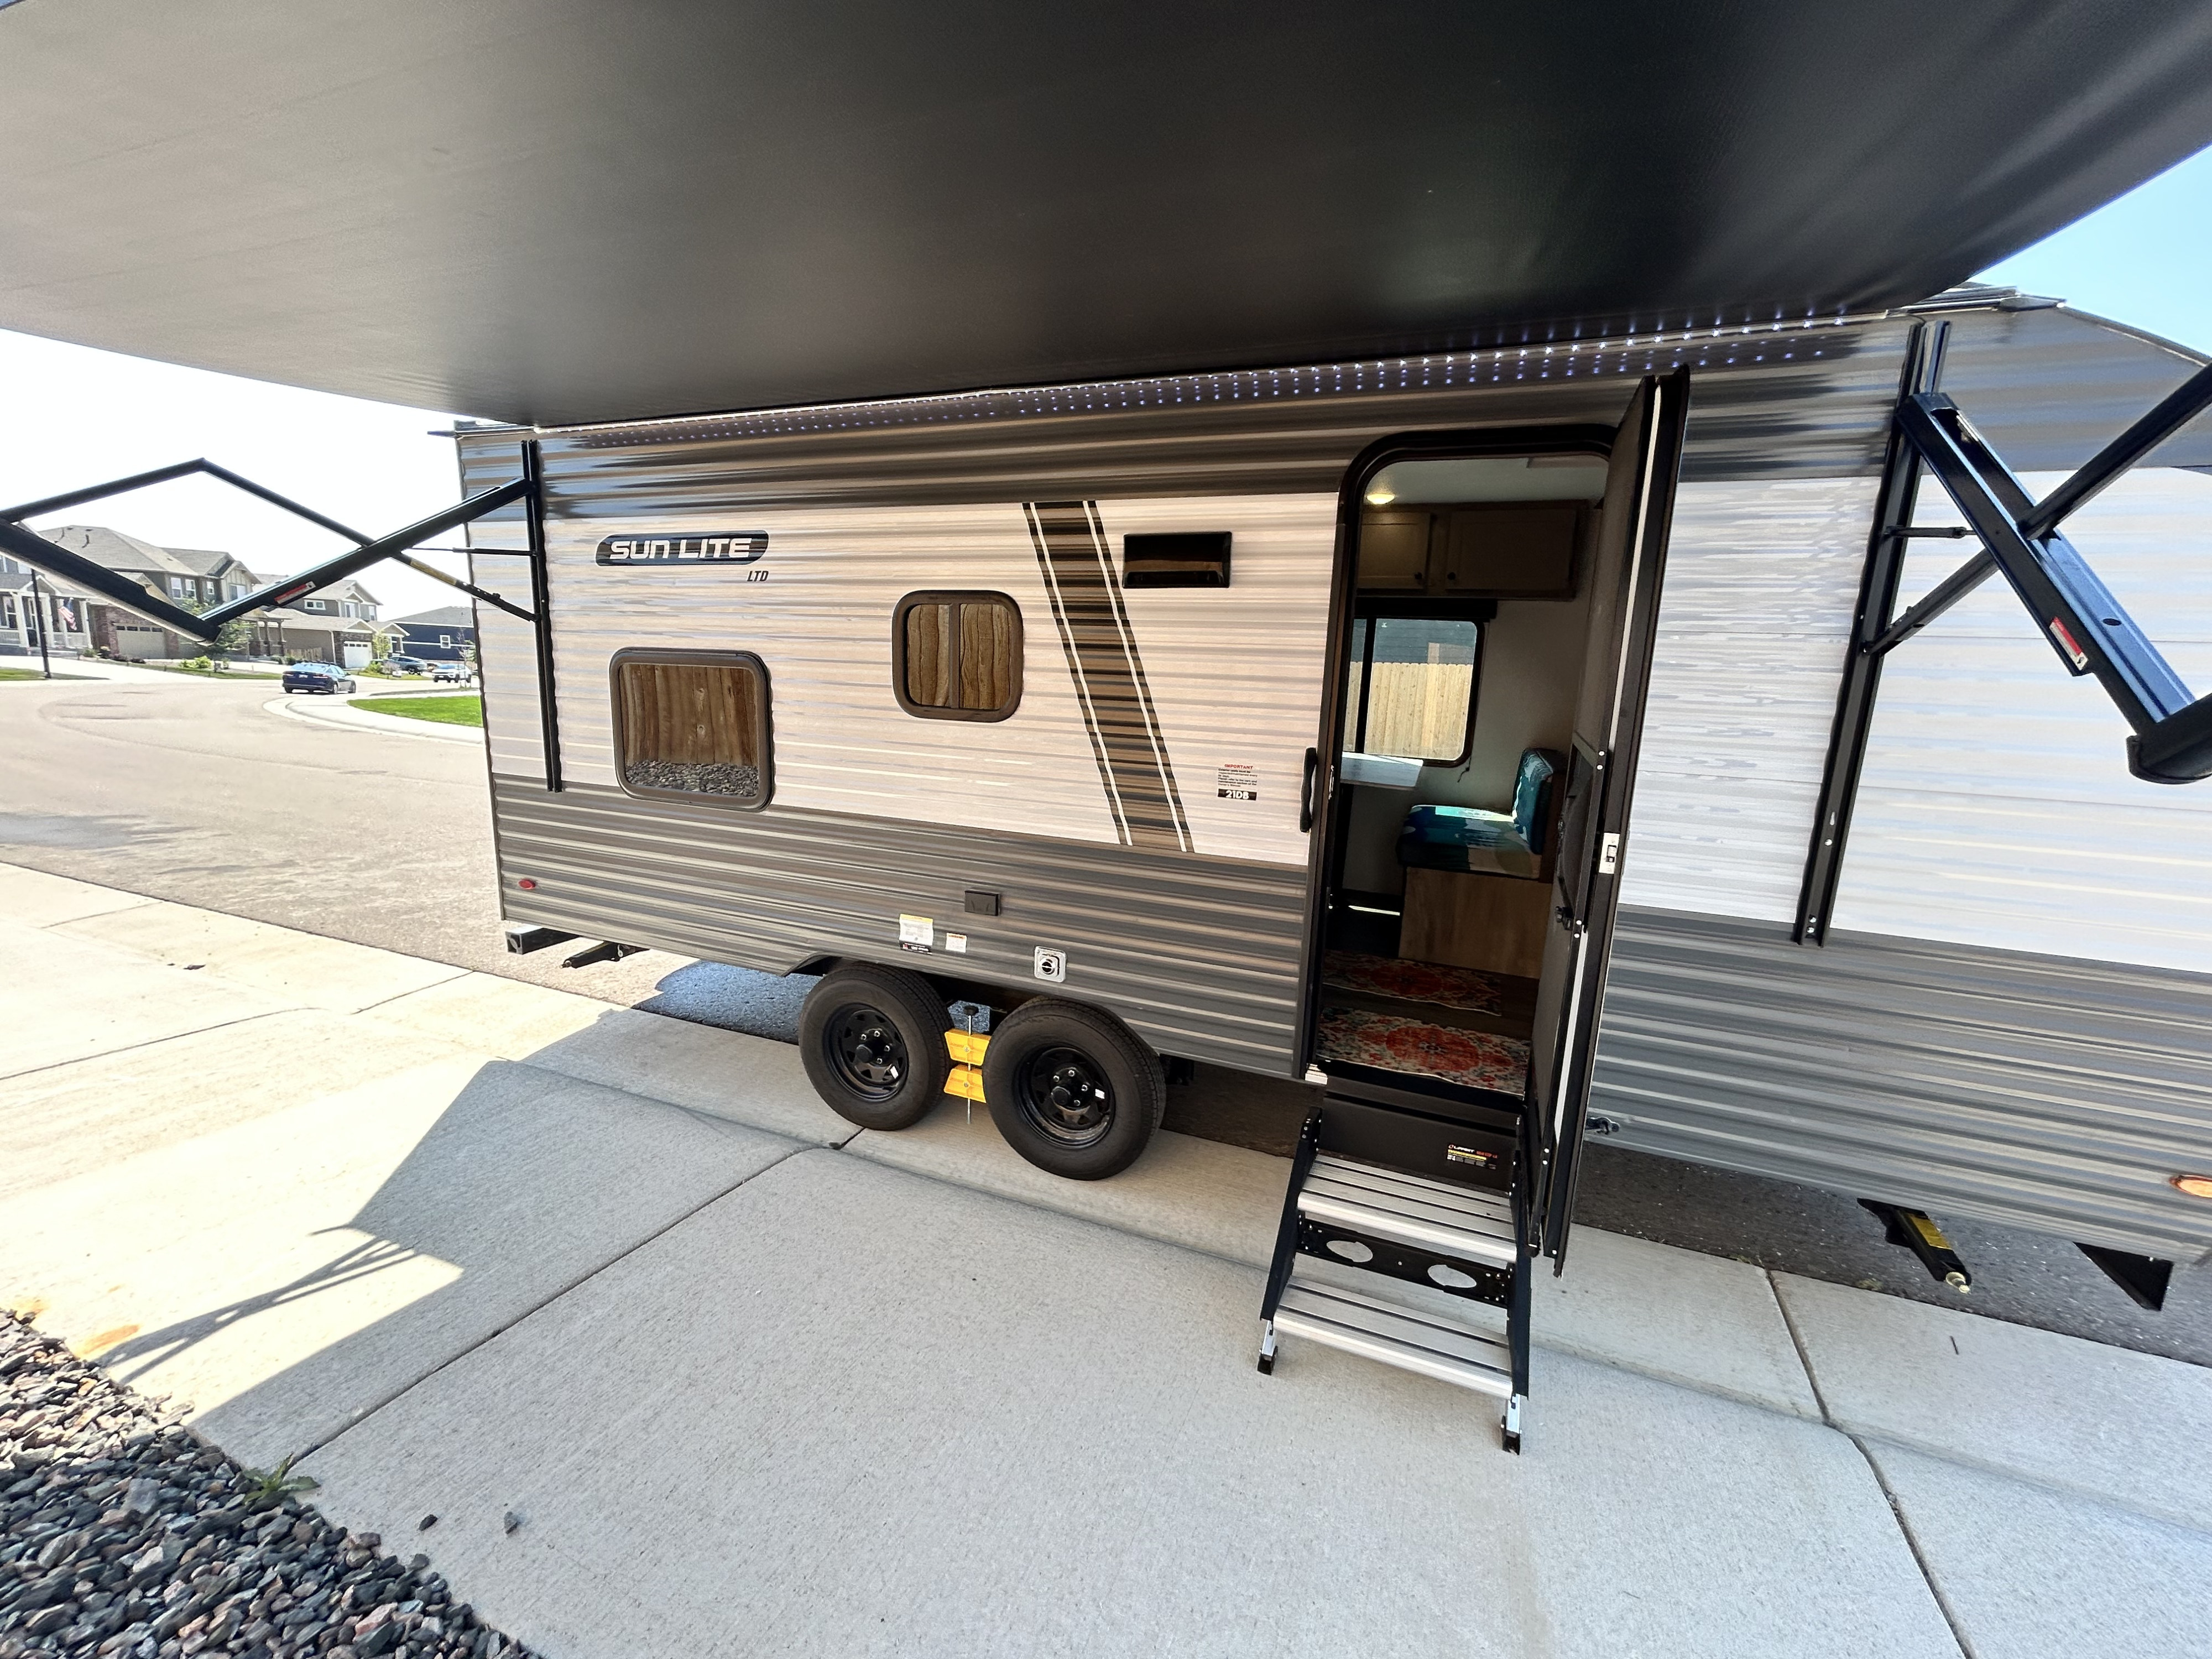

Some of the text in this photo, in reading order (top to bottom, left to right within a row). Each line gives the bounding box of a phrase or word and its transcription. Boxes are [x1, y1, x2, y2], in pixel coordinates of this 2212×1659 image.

[609, 538, 752, 559] SUN LITE
[747, 571, 769, 582] LTD
[1225, 790, 1249, 800] 21DB
